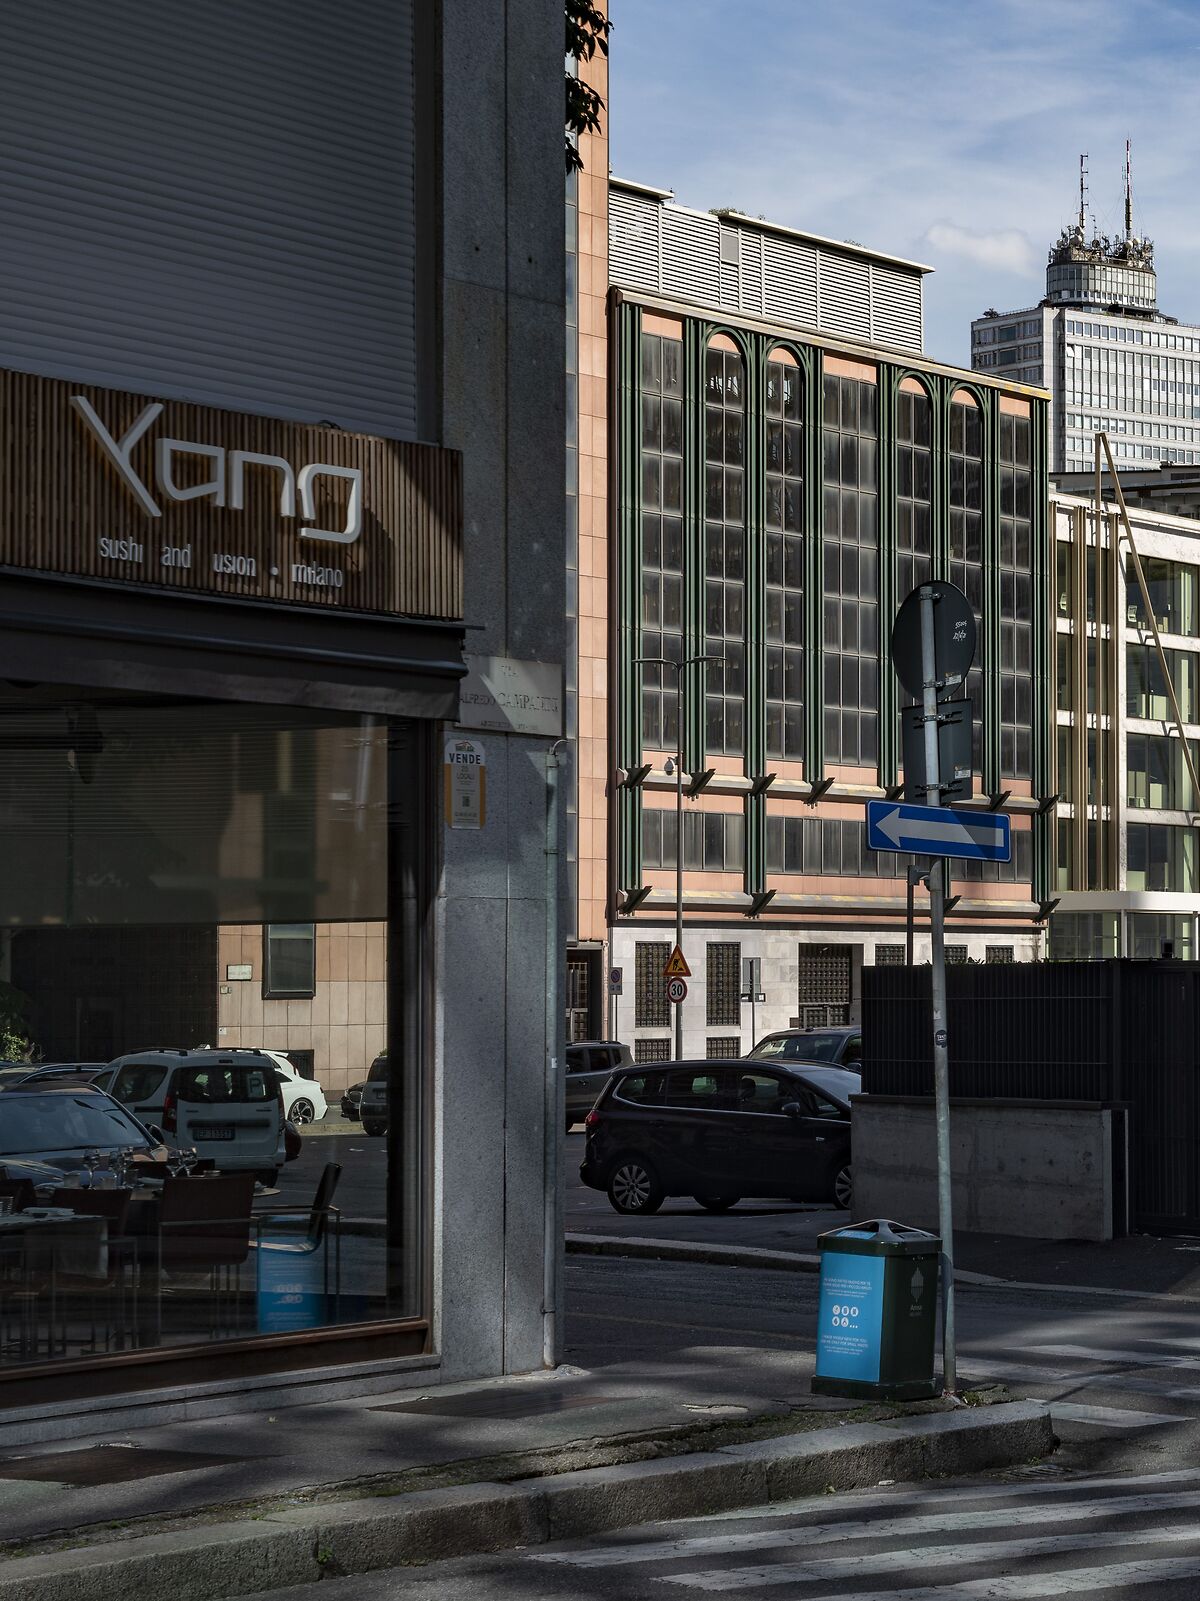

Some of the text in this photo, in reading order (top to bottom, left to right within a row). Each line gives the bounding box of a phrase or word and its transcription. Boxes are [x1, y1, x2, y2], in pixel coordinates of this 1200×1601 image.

[70, 395, 361, 544] Yang
[99, 536, 143, 564] sushi
[161, 543, 192, 569] and
[291, 560, 344, 588] milano
[449, 753, 481, 764] VENDE
[671, 984, 683, 996] 30
